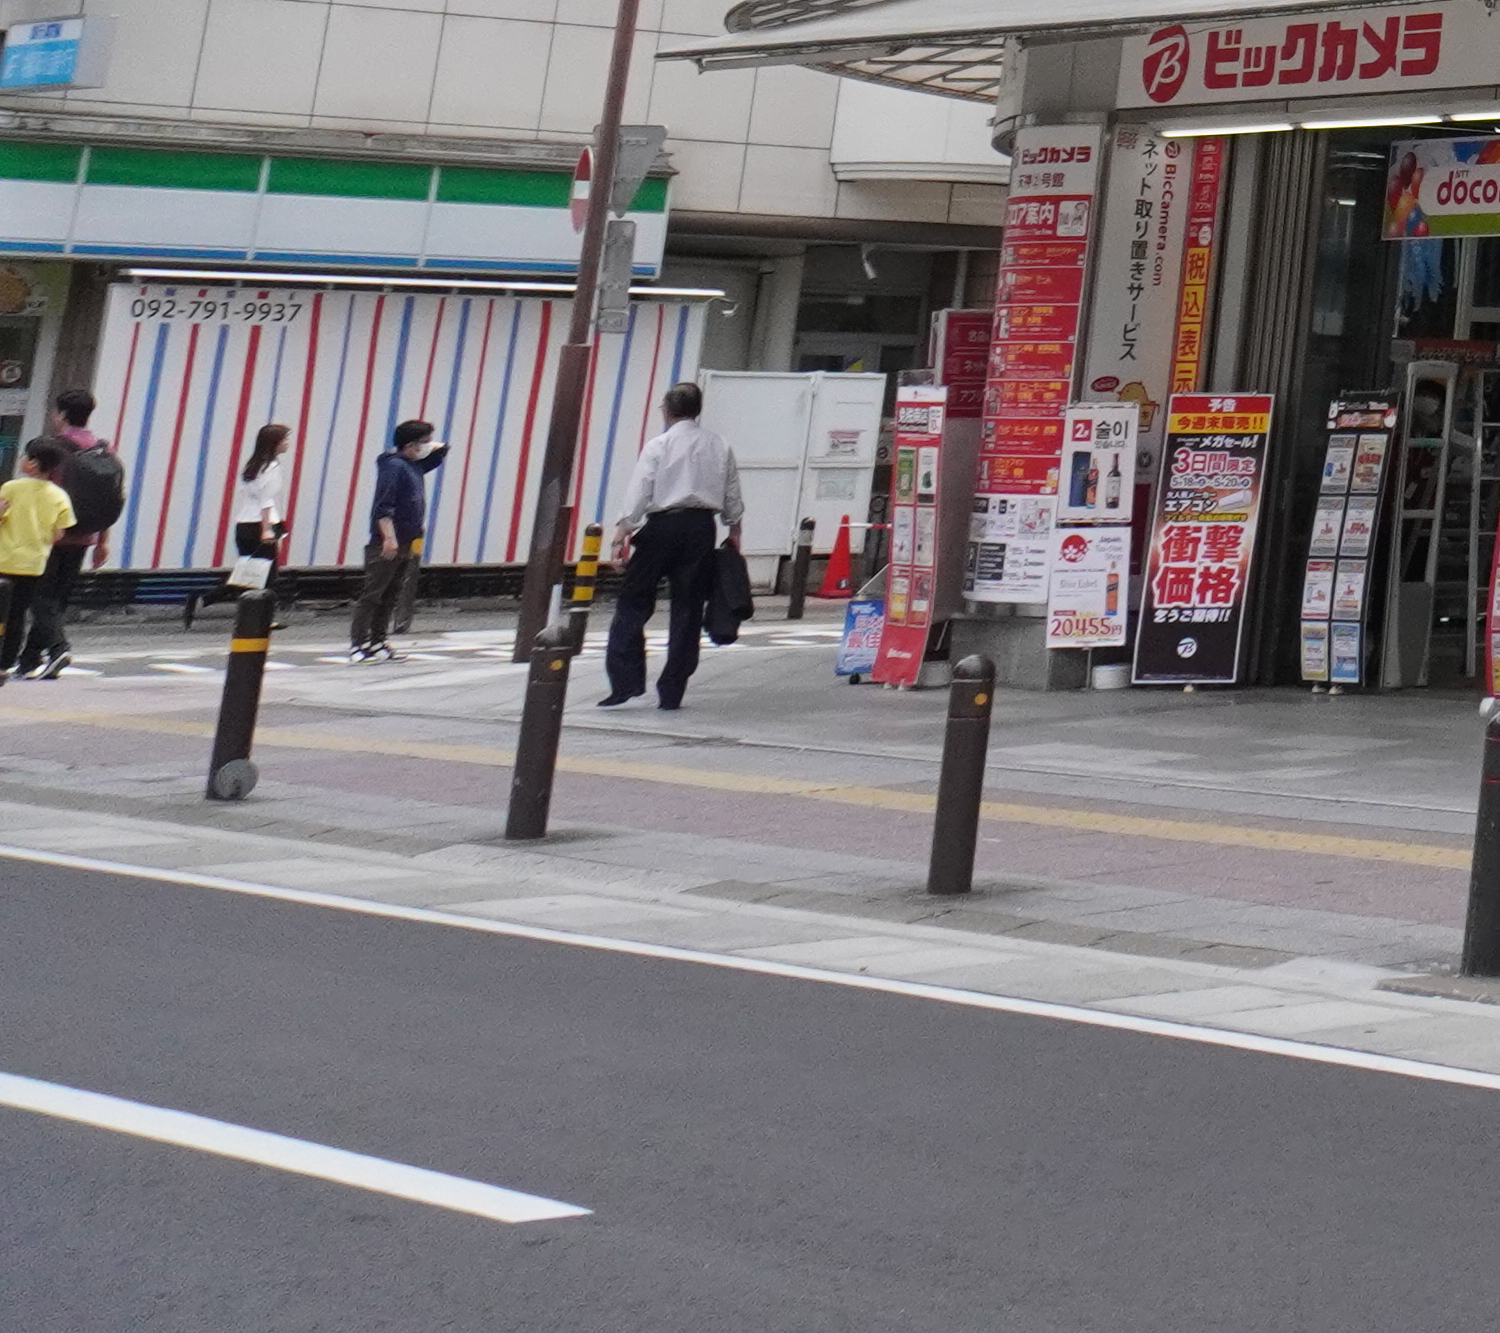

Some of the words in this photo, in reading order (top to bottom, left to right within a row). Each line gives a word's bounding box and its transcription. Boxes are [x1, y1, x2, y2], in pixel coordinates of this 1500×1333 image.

[1204, 12, 1443, 89] ビックカメラ
[1152, 165, 1177, 287] BicCamera.com
[1119, 140, 1159, 361] ネット取り置きサービス
[131, 299, 302, 324] 092-791-9937
[1164, 500, 1218, 512] エアコン
[1161, 524, 1244, 563] 衝撃
[1154, 566, 1238, 606] 価格
